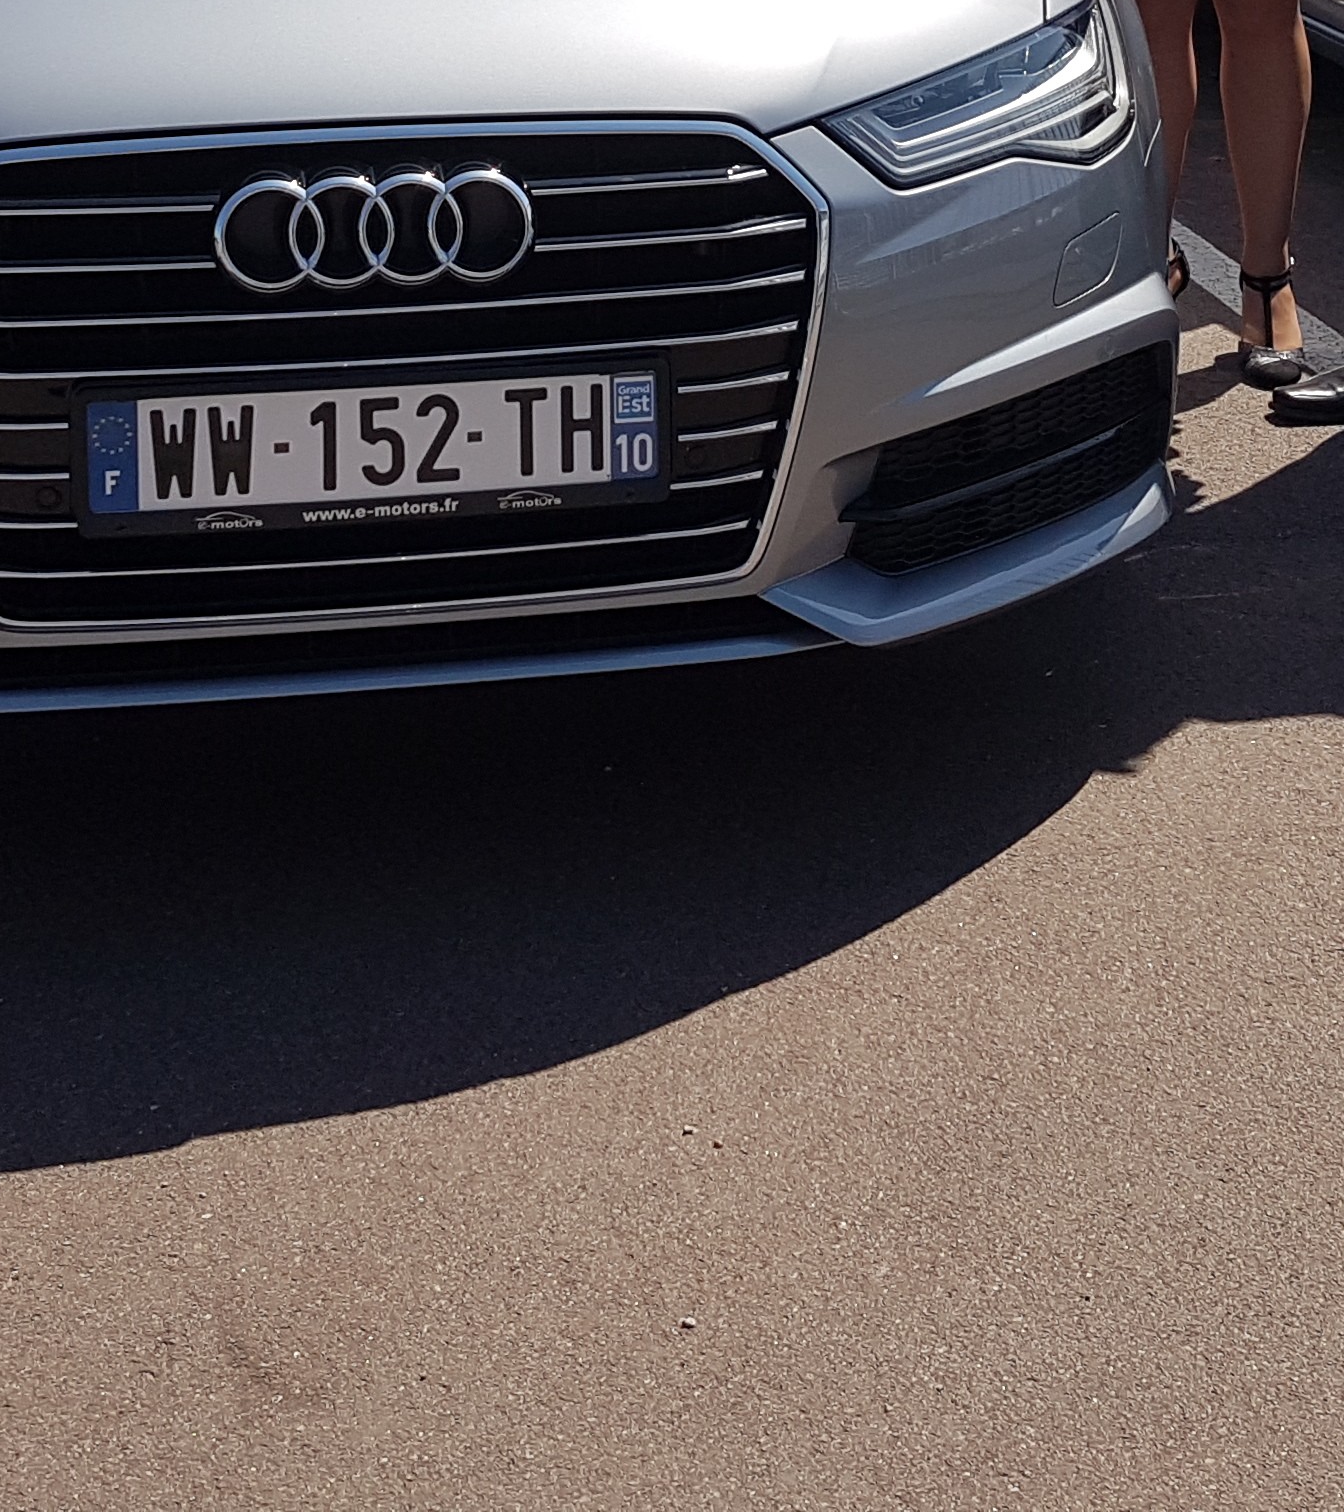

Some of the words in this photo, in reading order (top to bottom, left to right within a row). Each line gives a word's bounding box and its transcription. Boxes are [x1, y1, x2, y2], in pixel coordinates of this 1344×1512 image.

[618, 383, 650, 395] Grand
[617, 394, 651, 414] Est
[616, 432, 653, 474] 10
[104, 470, 121, 496] F
[302, 497, 460, 523] www.e-motors.fr
